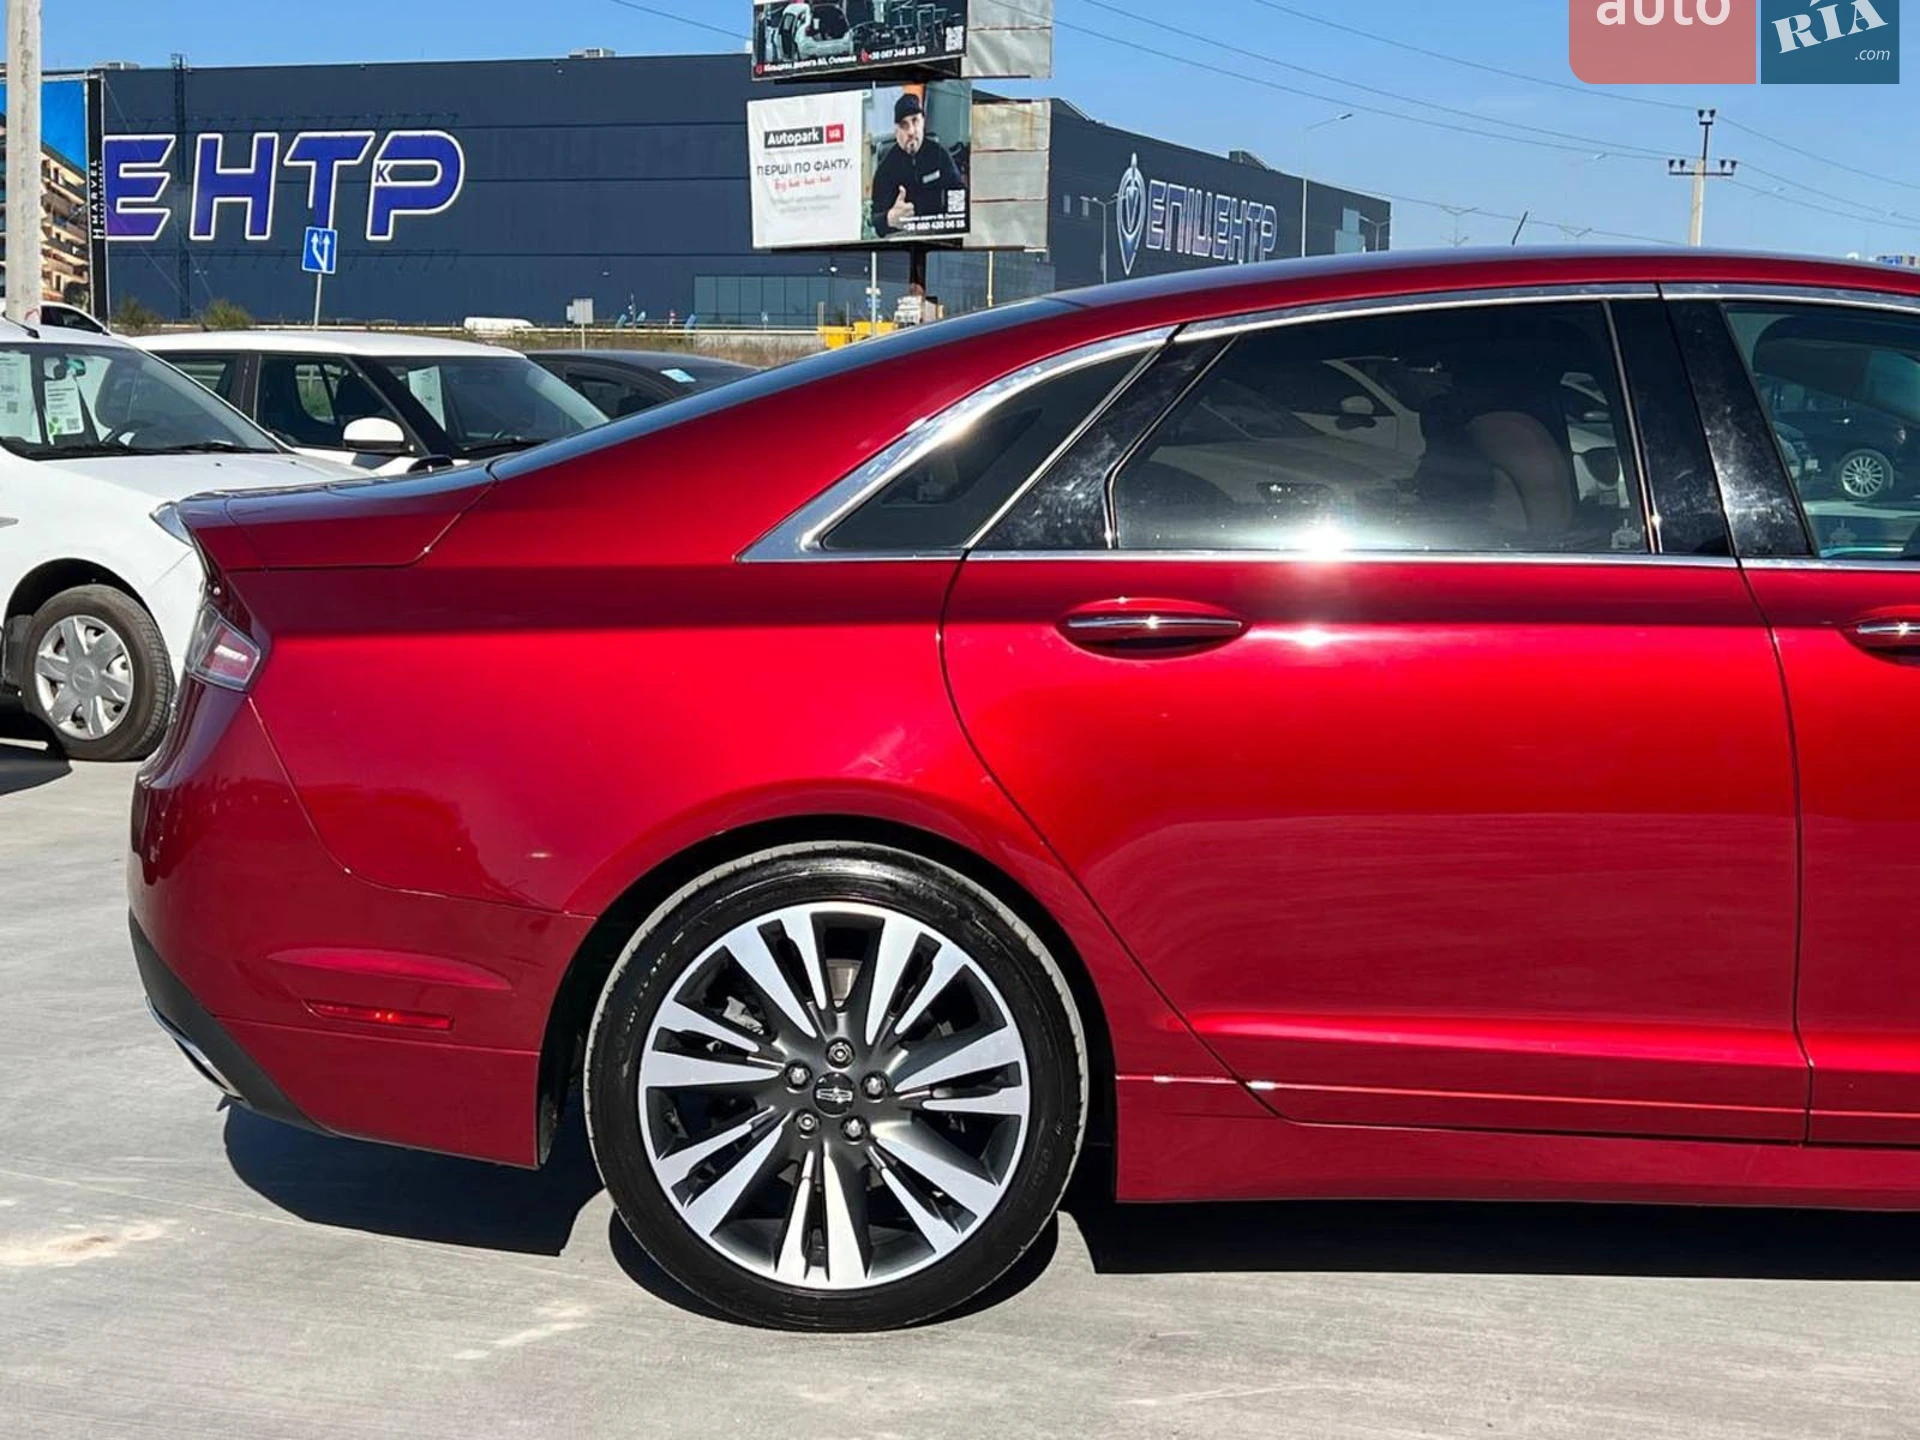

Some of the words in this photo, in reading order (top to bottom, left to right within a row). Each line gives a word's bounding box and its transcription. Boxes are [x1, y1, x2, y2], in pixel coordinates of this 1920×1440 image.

[767, 127, 819, 147] Autopark
[756, 162, 792, 177] ПЕРШІ
[794, 161, 811, 174] ПО
[90, 160, 99, 225] MARVEL
[1146, 179, 1278, 262] ЕПІЦЕНТР
